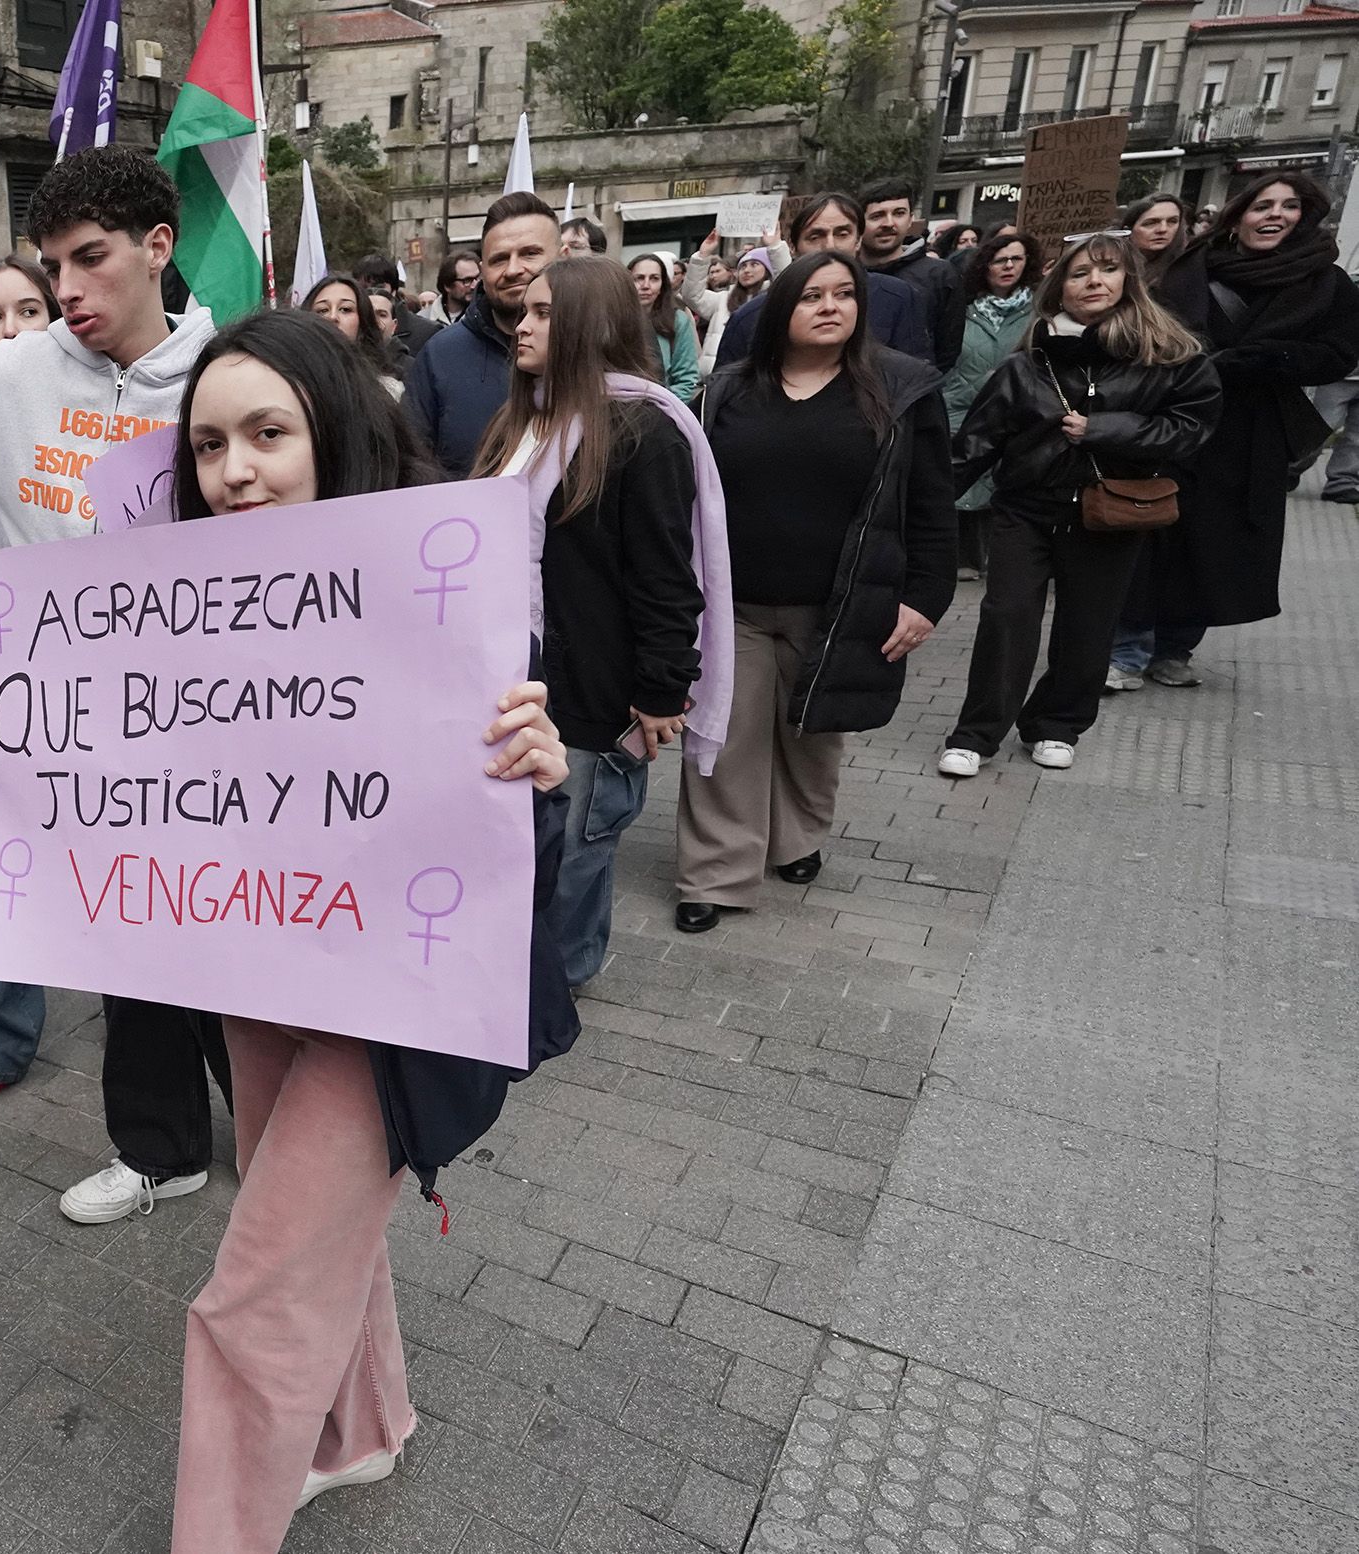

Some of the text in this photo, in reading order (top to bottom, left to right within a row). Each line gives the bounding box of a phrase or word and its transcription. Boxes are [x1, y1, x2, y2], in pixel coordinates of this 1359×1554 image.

[1025, 190, 1110, 211] MIGRANTES
[18, 477, 74, 514] STWD
[28, 568, 362, 662] AGRADEZCAN
[122, 671, 365, 739] BUSCAMOS
[265, 771, 295, 825] Y
[324, 769, 390, 828] NO
[68, 849, 364, 932] VENGANZA
